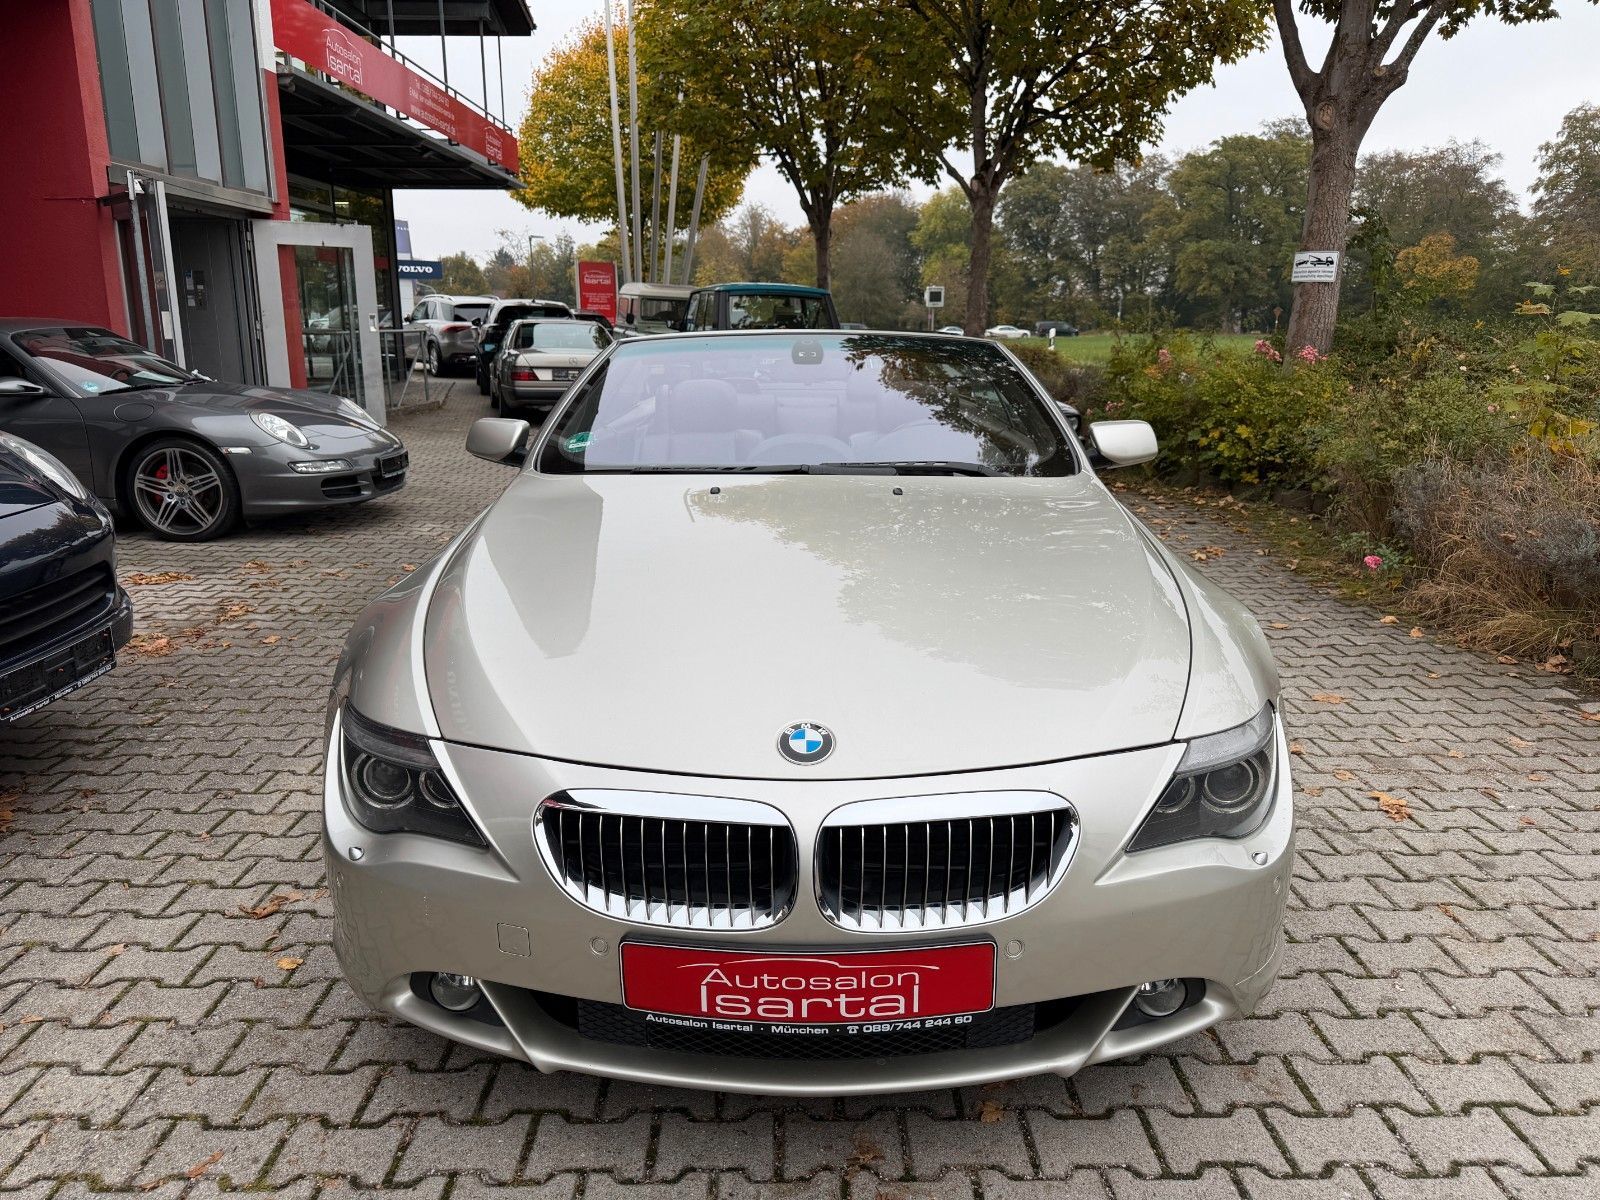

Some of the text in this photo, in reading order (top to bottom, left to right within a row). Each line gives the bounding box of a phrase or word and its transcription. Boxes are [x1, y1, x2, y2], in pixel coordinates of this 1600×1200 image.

[326, 36, 361, 65] Autosalon
[326, 48, 363, 86] Isartal
[785, 723, 828, 735] BMW
[701, 968, 920, 991] Autosalon
[700, 984, 920, 1018] Isartal
[645, 1013, 973, 1034] Autosalon Isartal München 089/744 244 60
